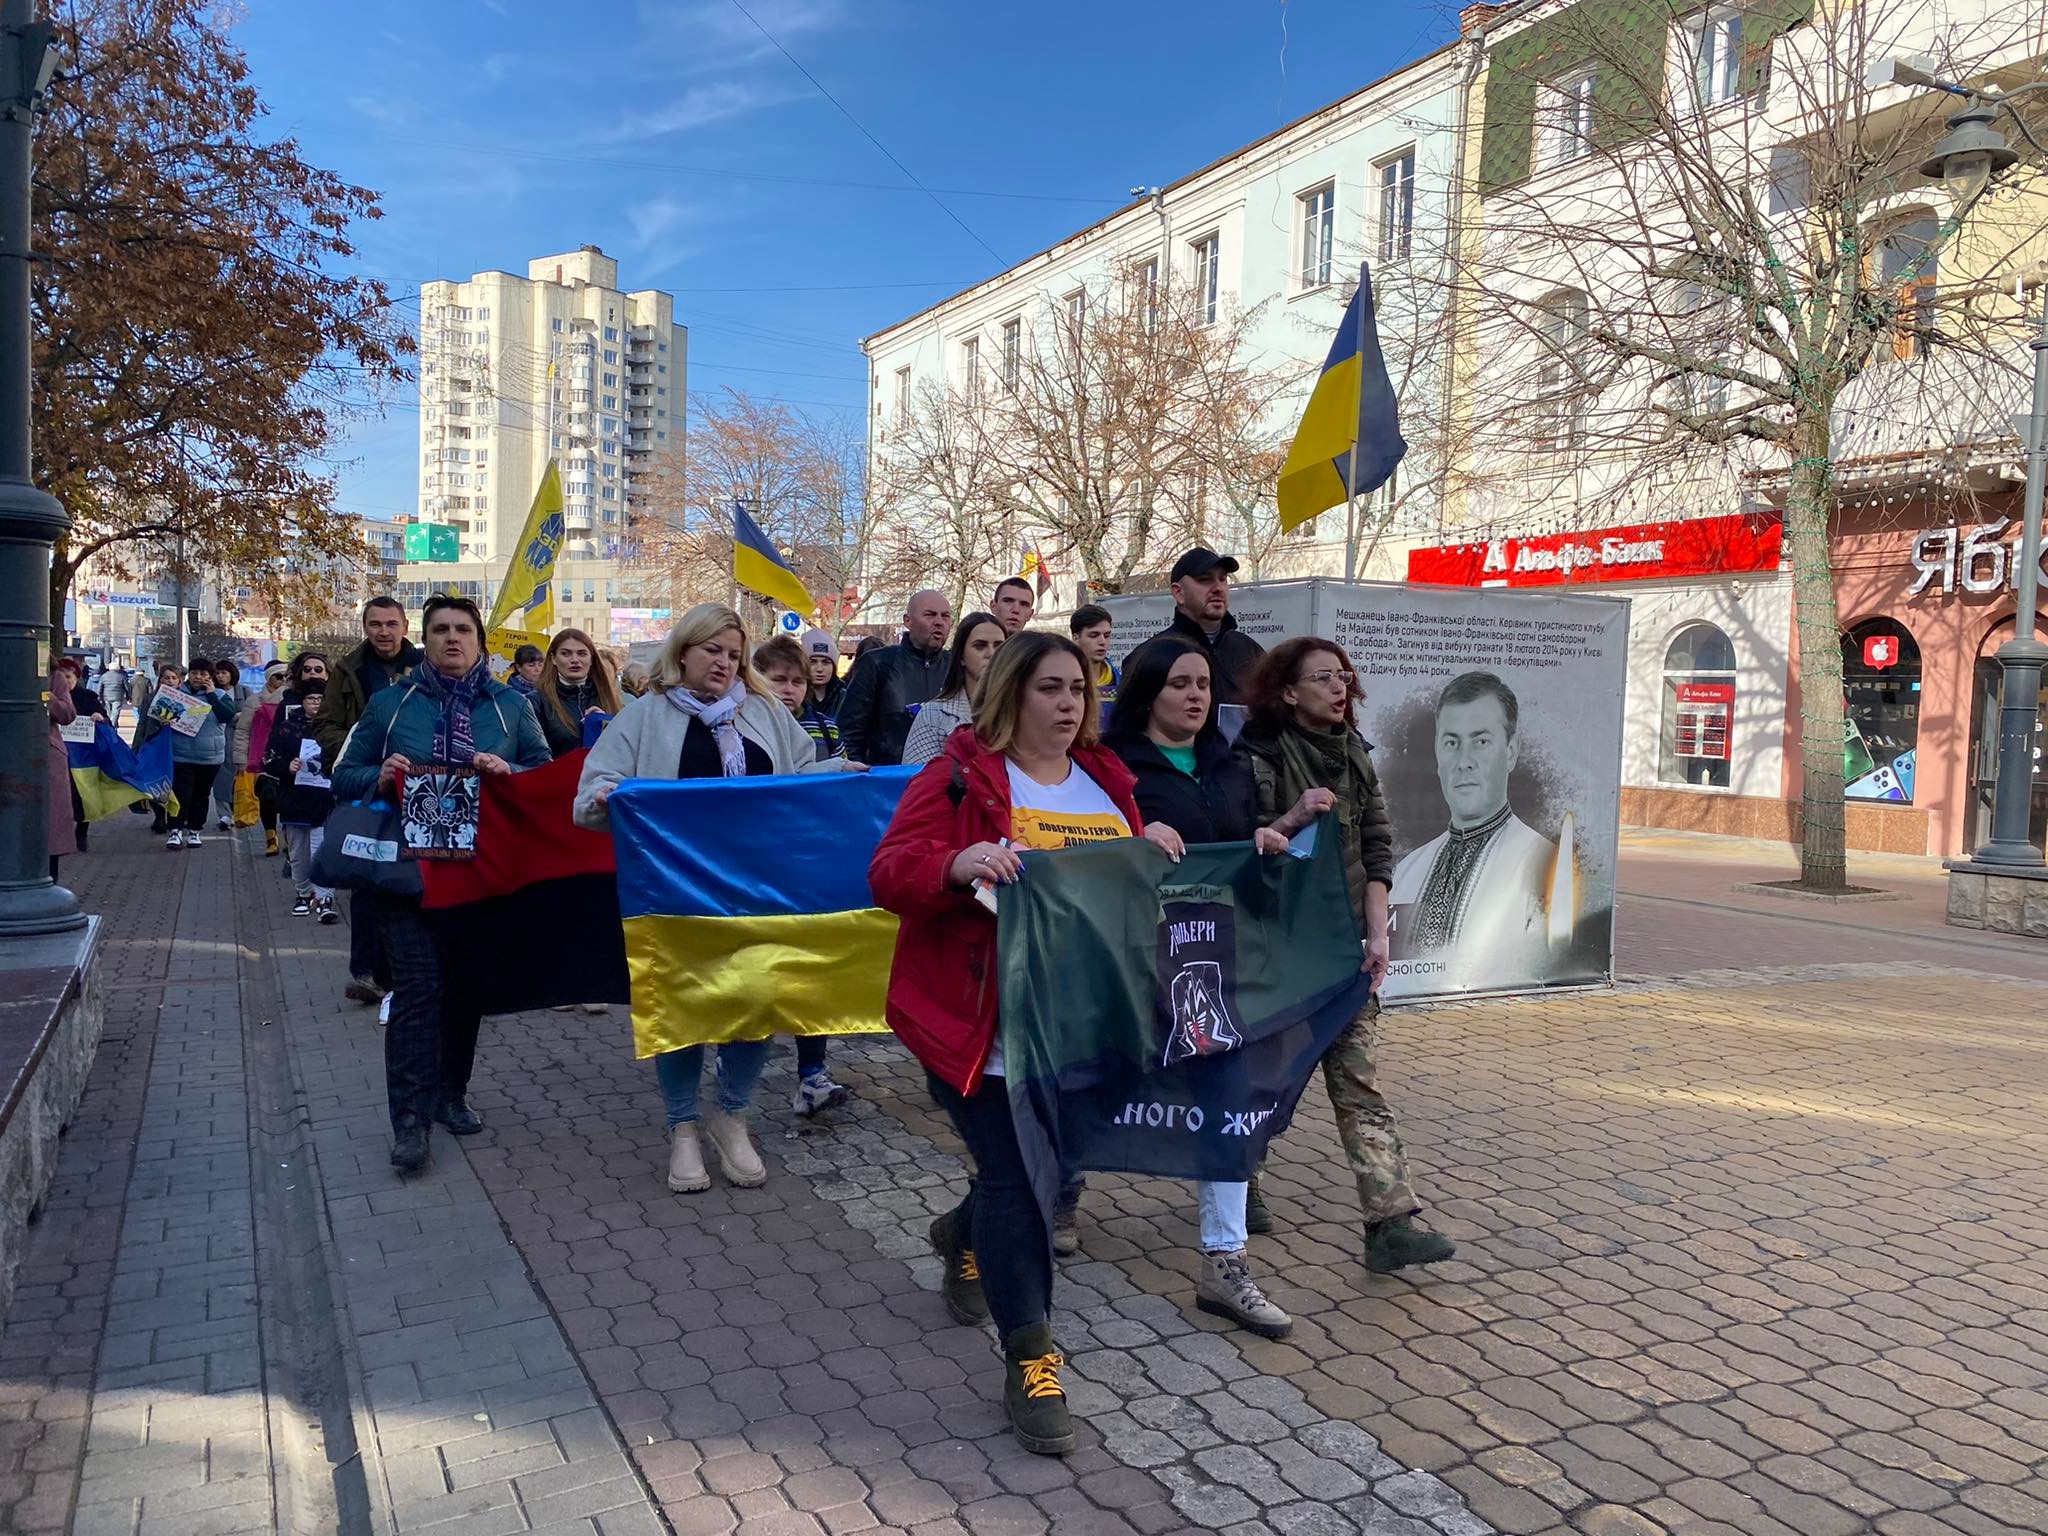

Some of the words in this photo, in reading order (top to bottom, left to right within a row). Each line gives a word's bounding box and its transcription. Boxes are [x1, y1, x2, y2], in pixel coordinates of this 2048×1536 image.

[1513, 536, 1665, 576] Альфа-Банк
[109, 595, 156, 605] SUZUKI
[1336, 609, 1386, 621] Мешканець
[1387, 611, 1465, 625] Івано-Франківської
[1466, 616, 1498, 627] області.
[1499, 617, 1533, 629] Керівник
[1534, 620, 1583, 632] туристичного
[1335, 623, 1347, 633] На
[1348, 622, 1384, 635] Майдані
[1385, 625, 1400, 637] був
[1401, 627, 1439, 637] сотником
[1440, 628, 1516, 641] Івано-Франківської
[1517, 632, 1536, 642] сотні
[1537, 633, 1586, 645] самооборони
[1335, 635, 1347, 646] ВО
[1397, 638, 1430, 650] Загинув
[1431, 640, 1443, 651] від
[1444, 640, 1472, 653] вибуху
[1473, 643, 1503, 654] гранати
[1505, 643, 1513, 653] 18
[1514, 645, 1541, 655] лютого
[1542, 645, 1559, 655] 2014
[1560, 647, 1577, 658] року
[1577, 648, 1583, 658] у
[1584, 647, 1603, 658] Києві
[1348, 650, 1362, 659] час
[1364, 652, 1398, 662] сутичок
[1400, 651, 1415, 662] між
[1416, 652, 1492, 666] мітингувальниками
[1493, 657, 1501, 665] та
[1369, 663, 1397, 677] Дідичу
[1399, 664, 1418, 677] було
[1419, 666, 1429, 675] 44
[1038, 821, 1089, 836] ПОВЕРНІТЬ
[1089, 825, 1120, 837] ГЕРОЇВ
[1386, 962, 1413, 977] СНОЇ
[1415, 962, 1446, 975] СОТНІ
[1114, 1102, 1204, 1132] НОГО
